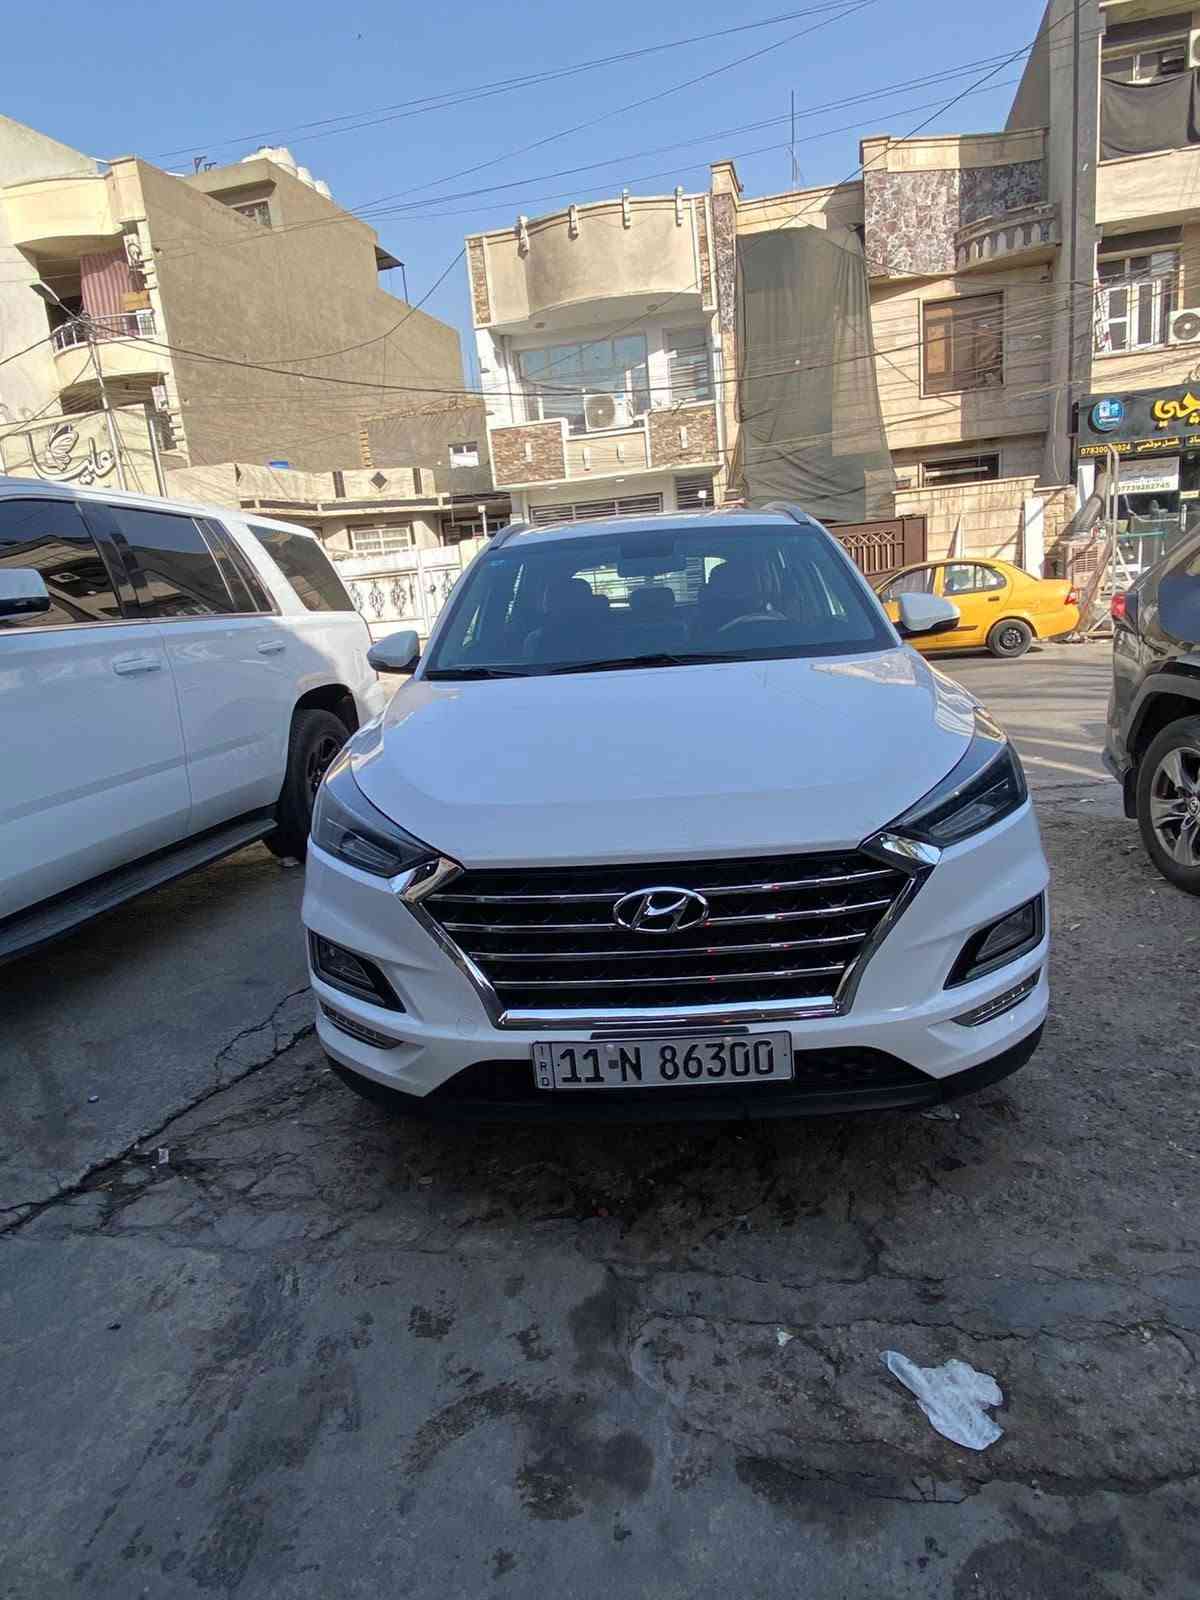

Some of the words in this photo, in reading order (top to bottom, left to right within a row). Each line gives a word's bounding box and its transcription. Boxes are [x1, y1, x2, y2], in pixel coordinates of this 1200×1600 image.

[560, 1048, 604, 1082] 11
[619, 1047, 642, 1082] N
[659, 1040, 774, 1080] 86300
